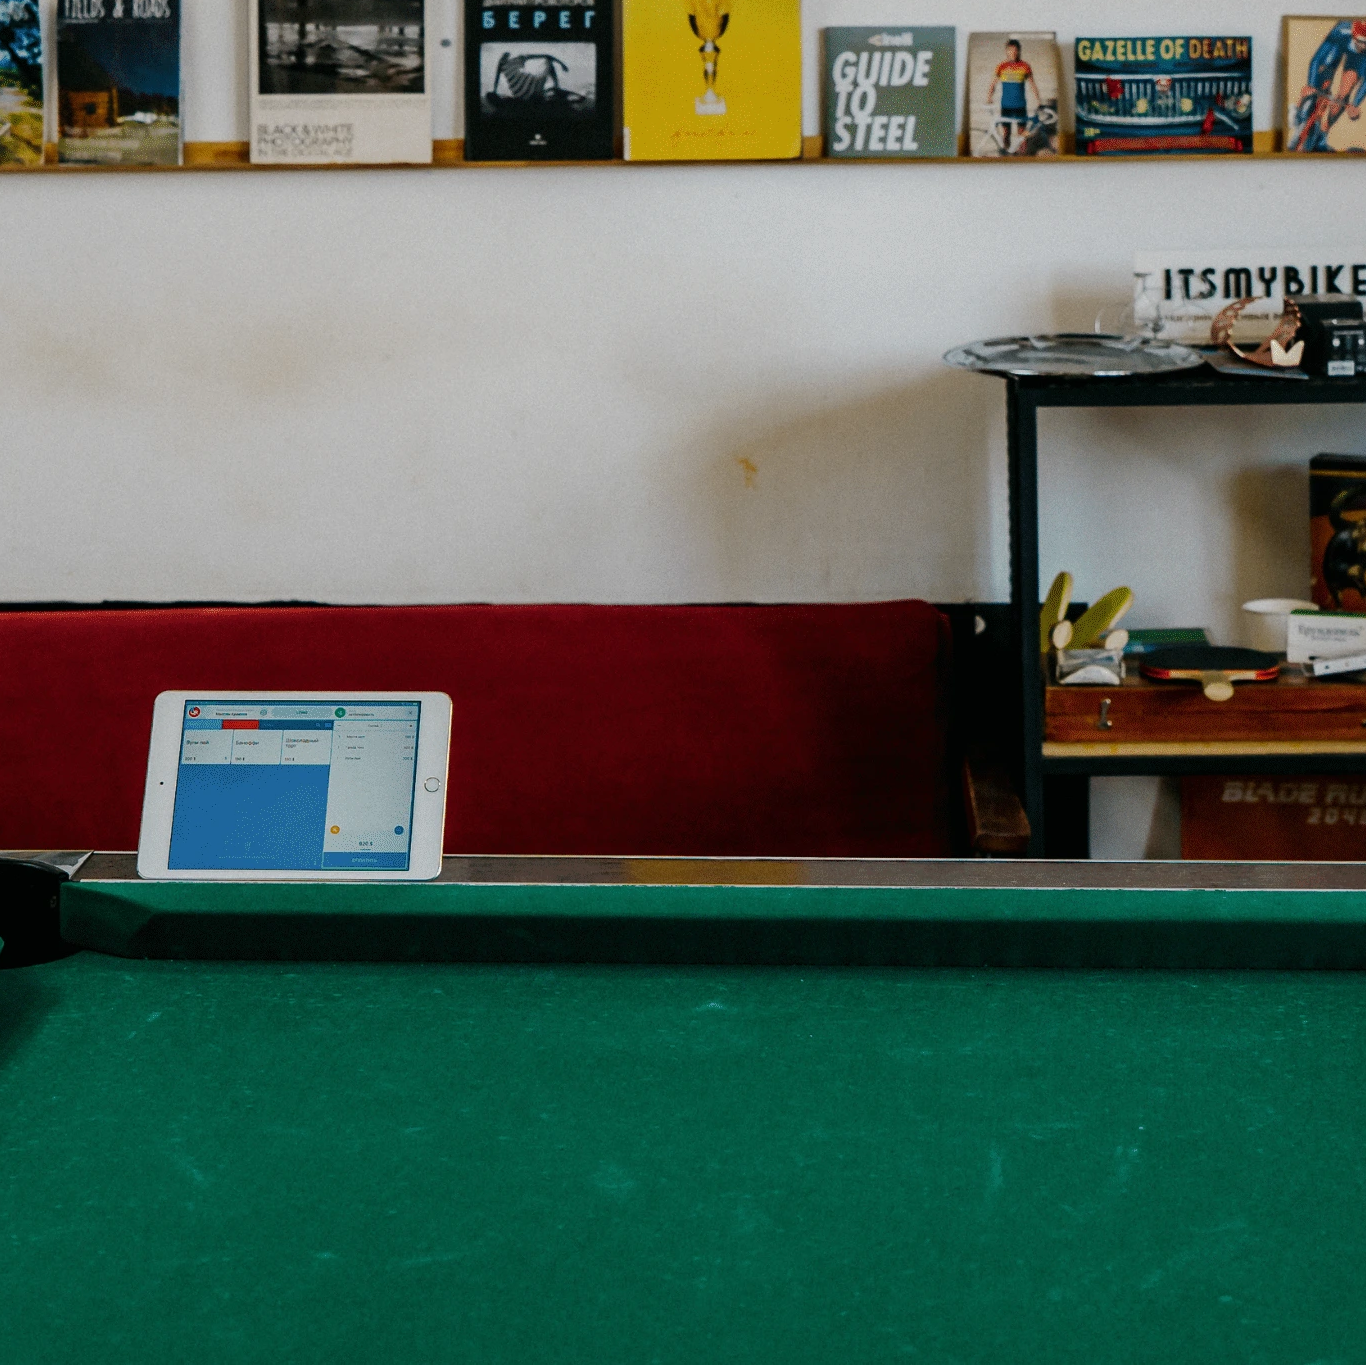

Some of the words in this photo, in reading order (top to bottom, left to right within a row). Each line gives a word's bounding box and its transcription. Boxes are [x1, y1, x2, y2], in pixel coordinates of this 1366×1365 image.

[482, 10, 596, 30] БЕРЕГ
[1077, 38, 1155, 62] GAZELLE
[1159, 38, 1185, 61] OF
[1188, 37, 1249, 61] DEATH
[831, 50, 934, 87] GUIDE
[836, 84, 877, 122] TO
[257, 136, 354, 148] PHOTOGRAPHY
[312, 123, 354, 136] WHITE
[832, 114, 919, 152] STEEL
[1220, 780, 1321, 805] BLADE
